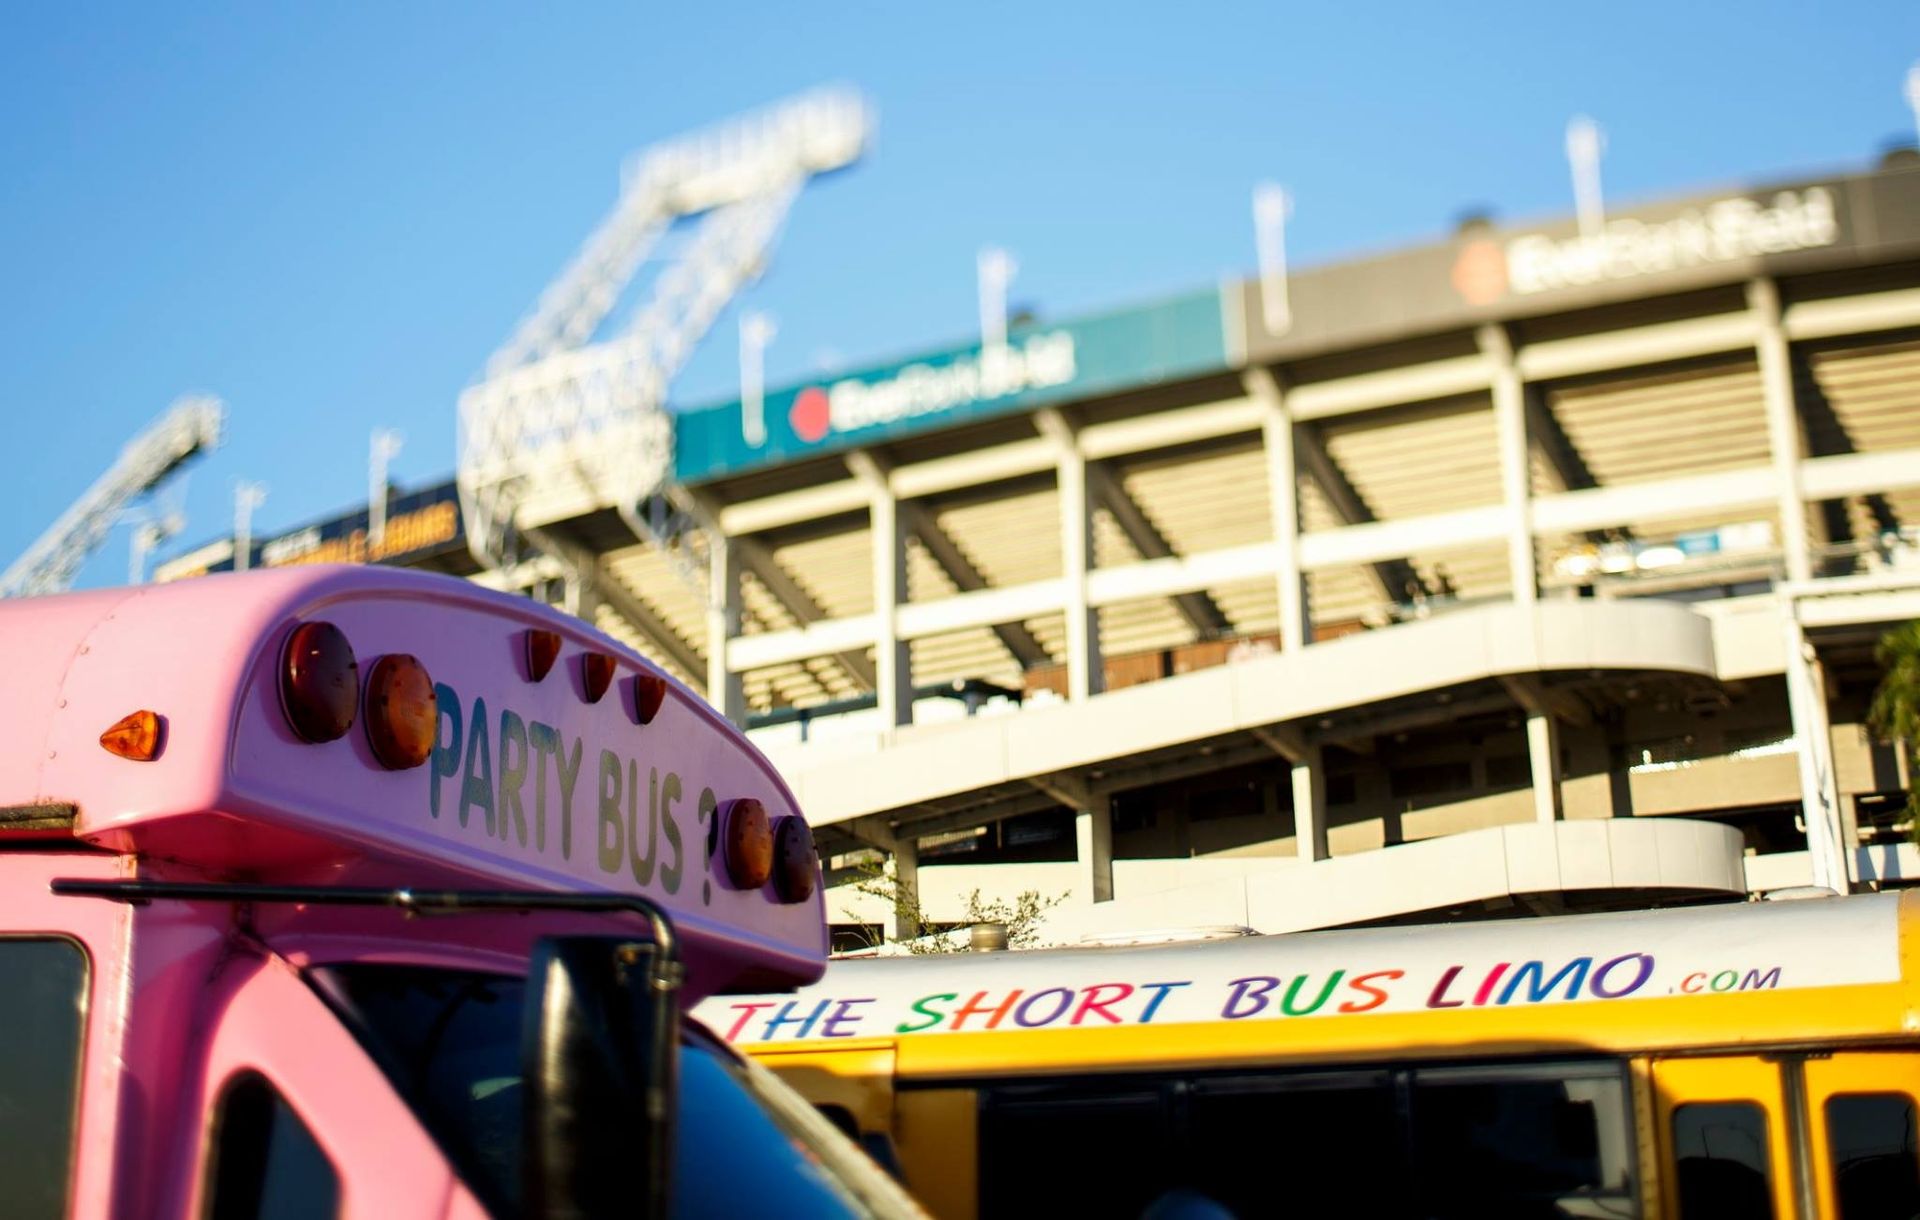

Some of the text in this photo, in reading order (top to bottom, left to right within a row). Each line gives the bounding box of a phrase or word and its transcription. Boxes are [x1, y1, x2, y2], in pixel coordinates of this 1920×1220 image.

[430, 682, 720, 907] PARTY BUS ?
[725, 998, 877, 1042] THE
[895, 980, 1194, 1034] SHORT
[1220, 968, 1405, 1020] BUS
[1425, 952, 1656, 1010] LIMO
